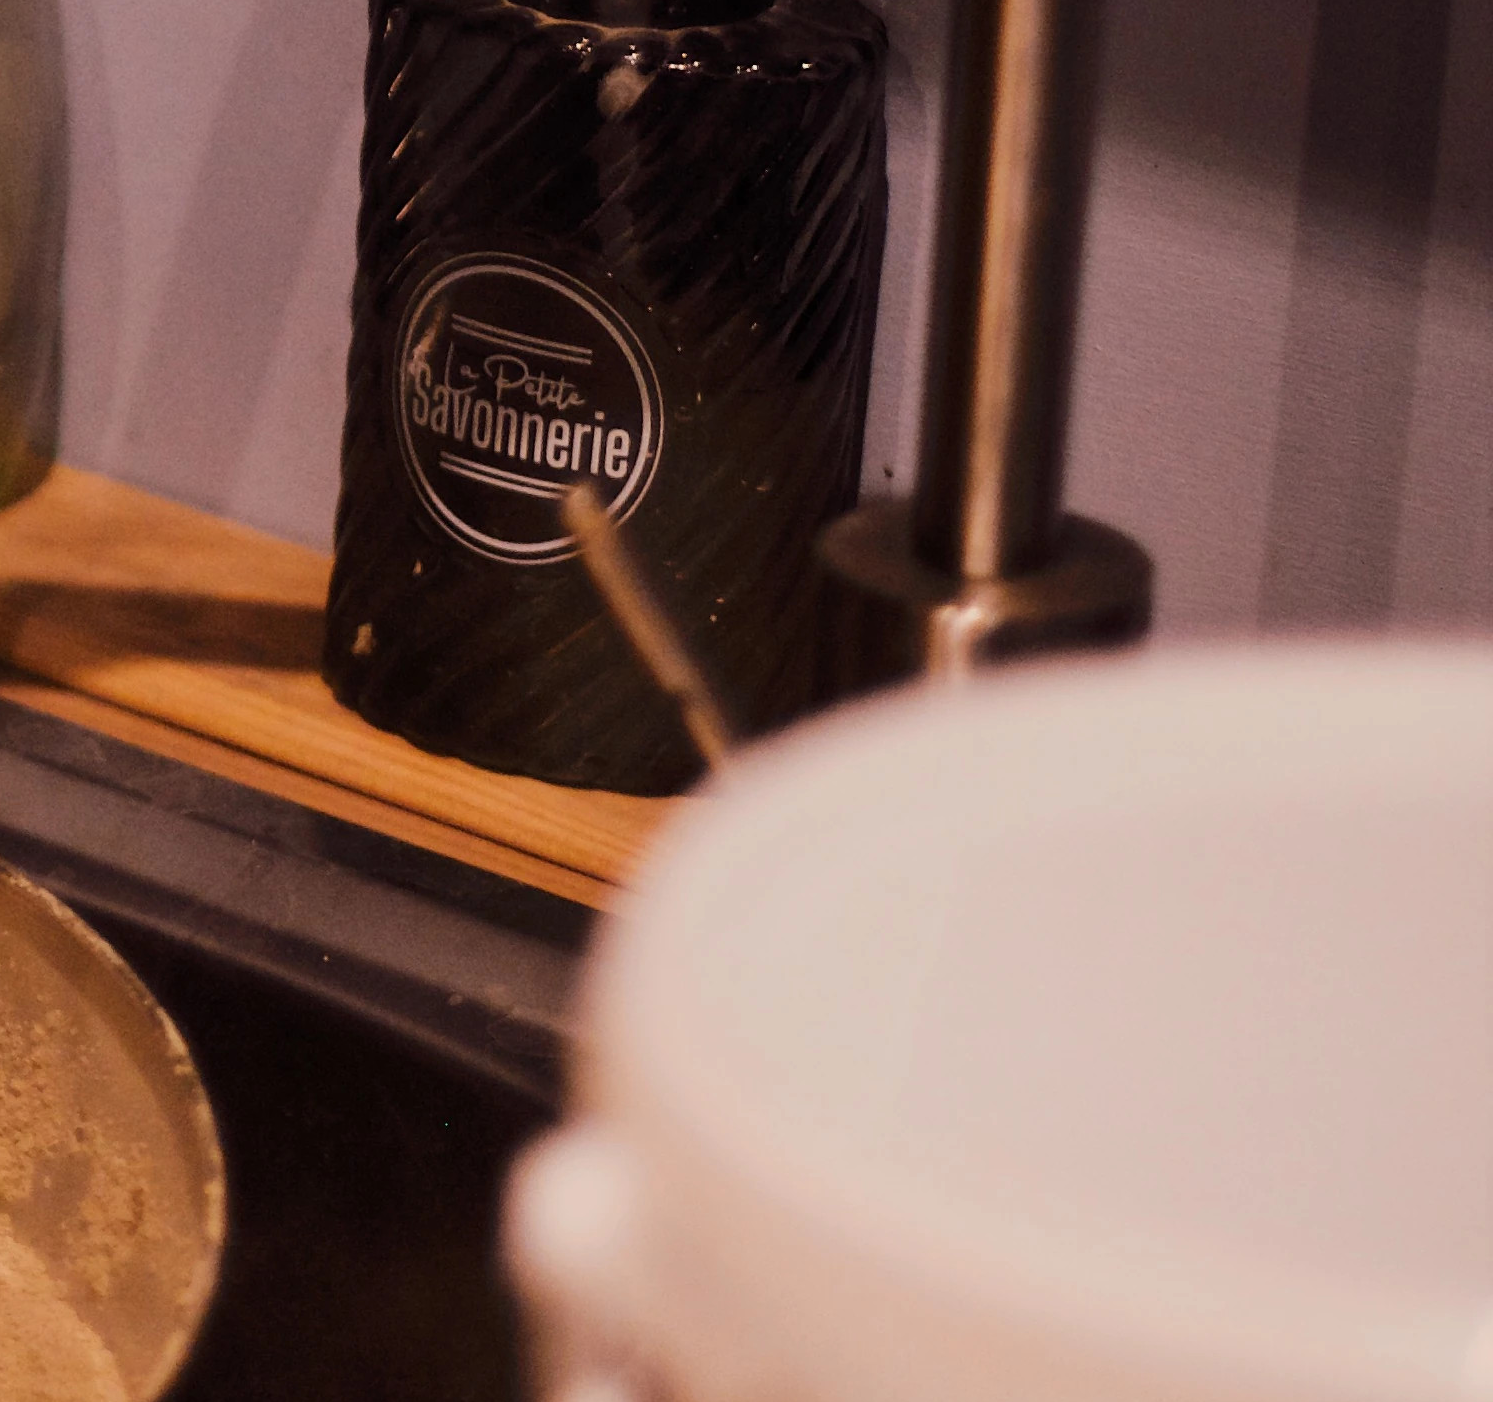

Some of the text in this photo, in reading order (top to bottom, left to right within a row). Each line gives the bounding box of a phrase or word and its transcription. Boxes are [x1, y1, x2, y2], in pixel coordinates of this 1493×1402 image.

[412, 362, 631, 479] Savonnerie
[444, 341, 585, 410] La Petite
